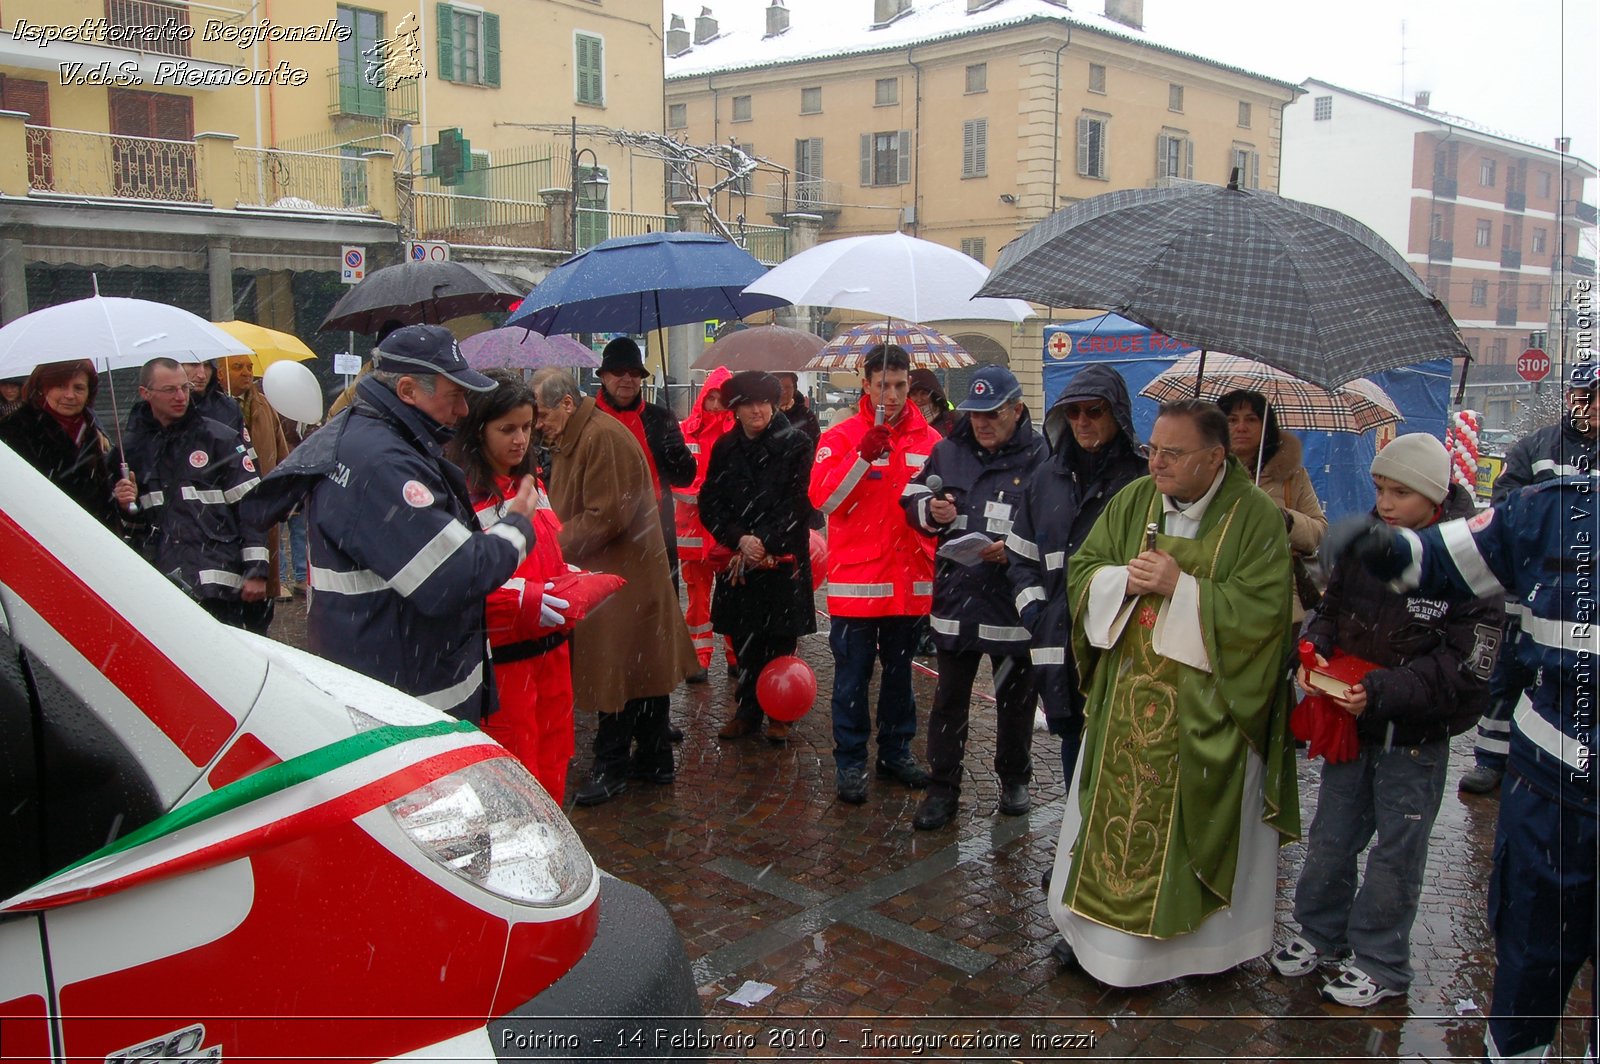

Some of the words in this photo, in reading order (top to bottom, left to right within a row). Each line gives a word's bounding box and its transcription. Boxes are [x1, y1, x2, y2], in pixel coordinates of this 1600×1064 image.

[1076, 334, 1144, 354] CROCE
[1518, 358, 1549, 372] STOP
[1421, 606, 1443, 618] RUES
